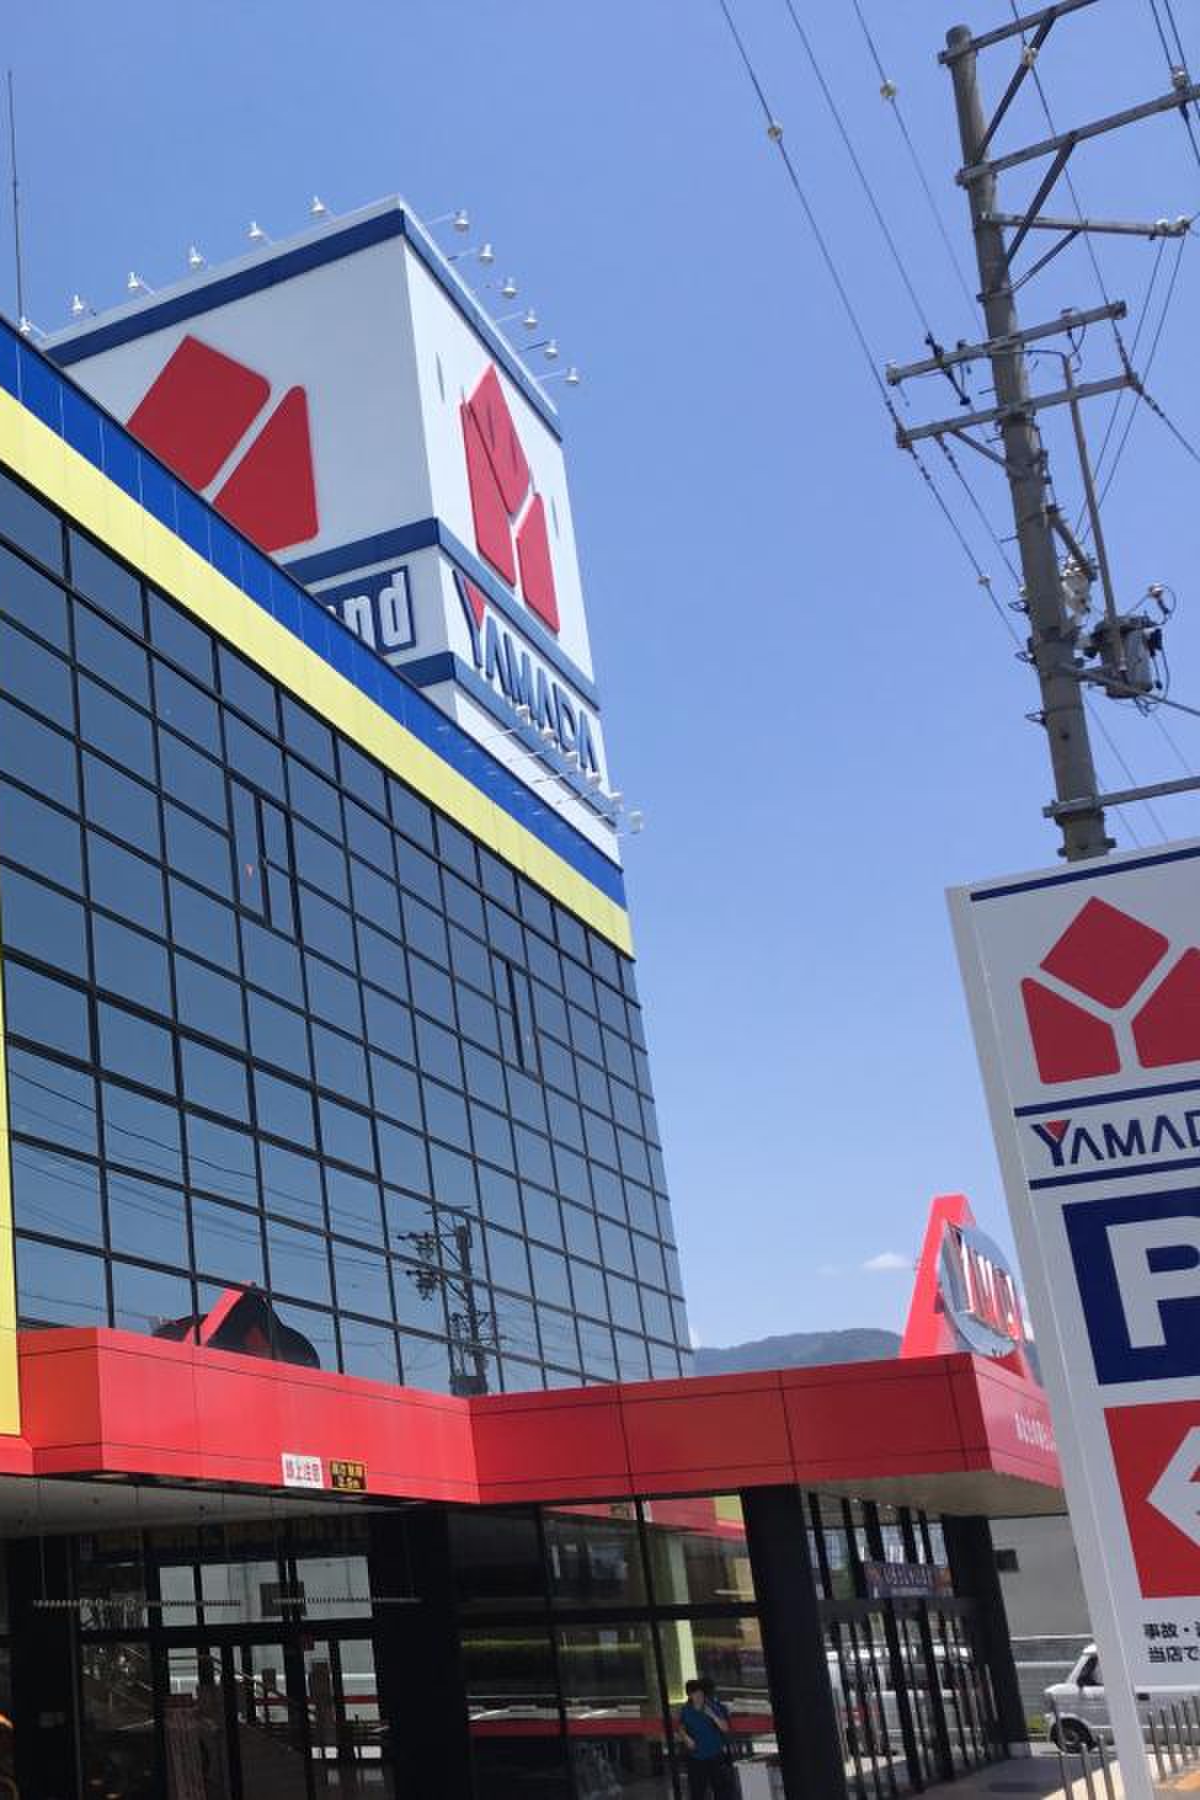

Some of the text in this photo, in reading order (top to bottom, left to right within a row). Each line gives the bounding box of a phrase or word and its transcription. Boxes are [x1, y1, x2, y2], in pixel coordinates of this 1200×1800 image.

[326, 569, 412, 649] nd
[452, 569, 599, 773] YAMADA
[1105, 1215, 1200, 1349] P
